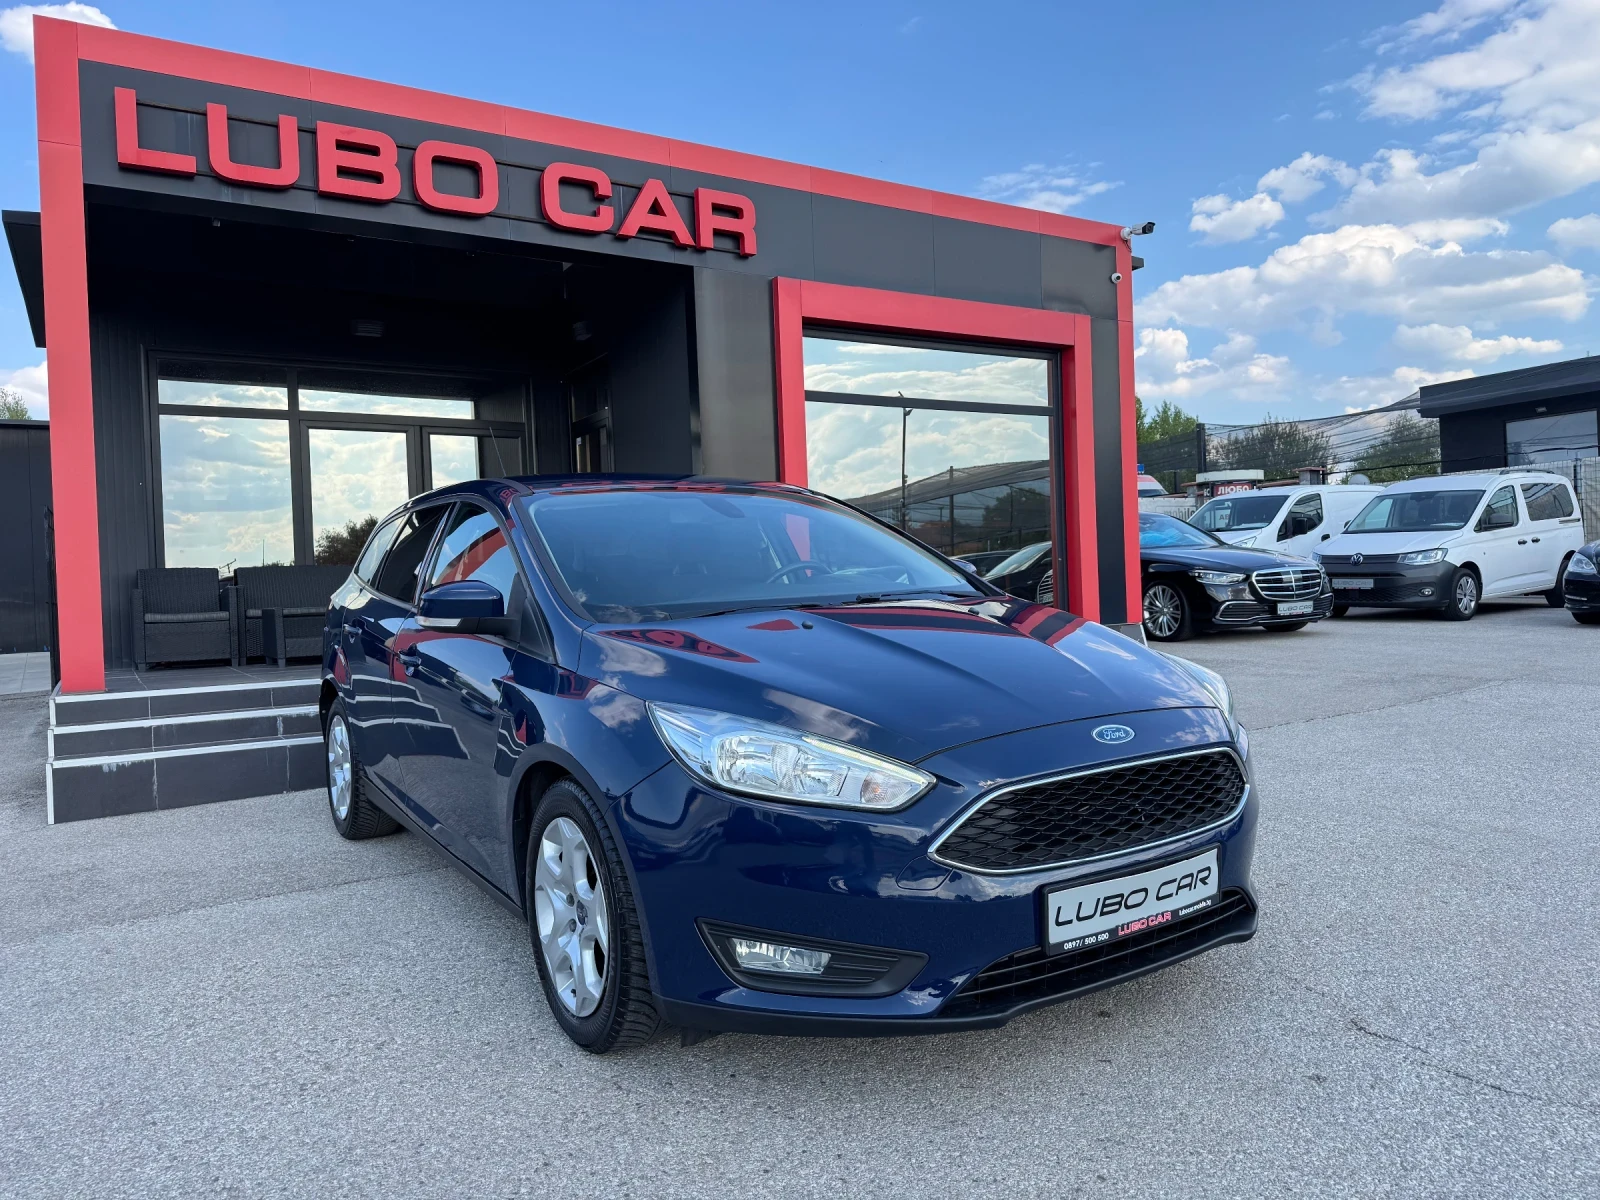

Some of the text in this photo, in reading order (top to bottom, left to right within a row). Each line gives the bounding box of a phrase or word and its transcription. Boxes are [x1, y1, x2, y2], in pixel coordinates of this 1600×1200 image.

[114, 86, 758, 258] LUBO CAR
[1102, 727, 1126, 740] Ford
[1055, 865, 1211, 927] LUBO CAR
[1118, 911, 1172, 936] LUBO CAR
[1063, 939, 1084, 950] 0897/
[1084, 936, 1097, 945] 500
